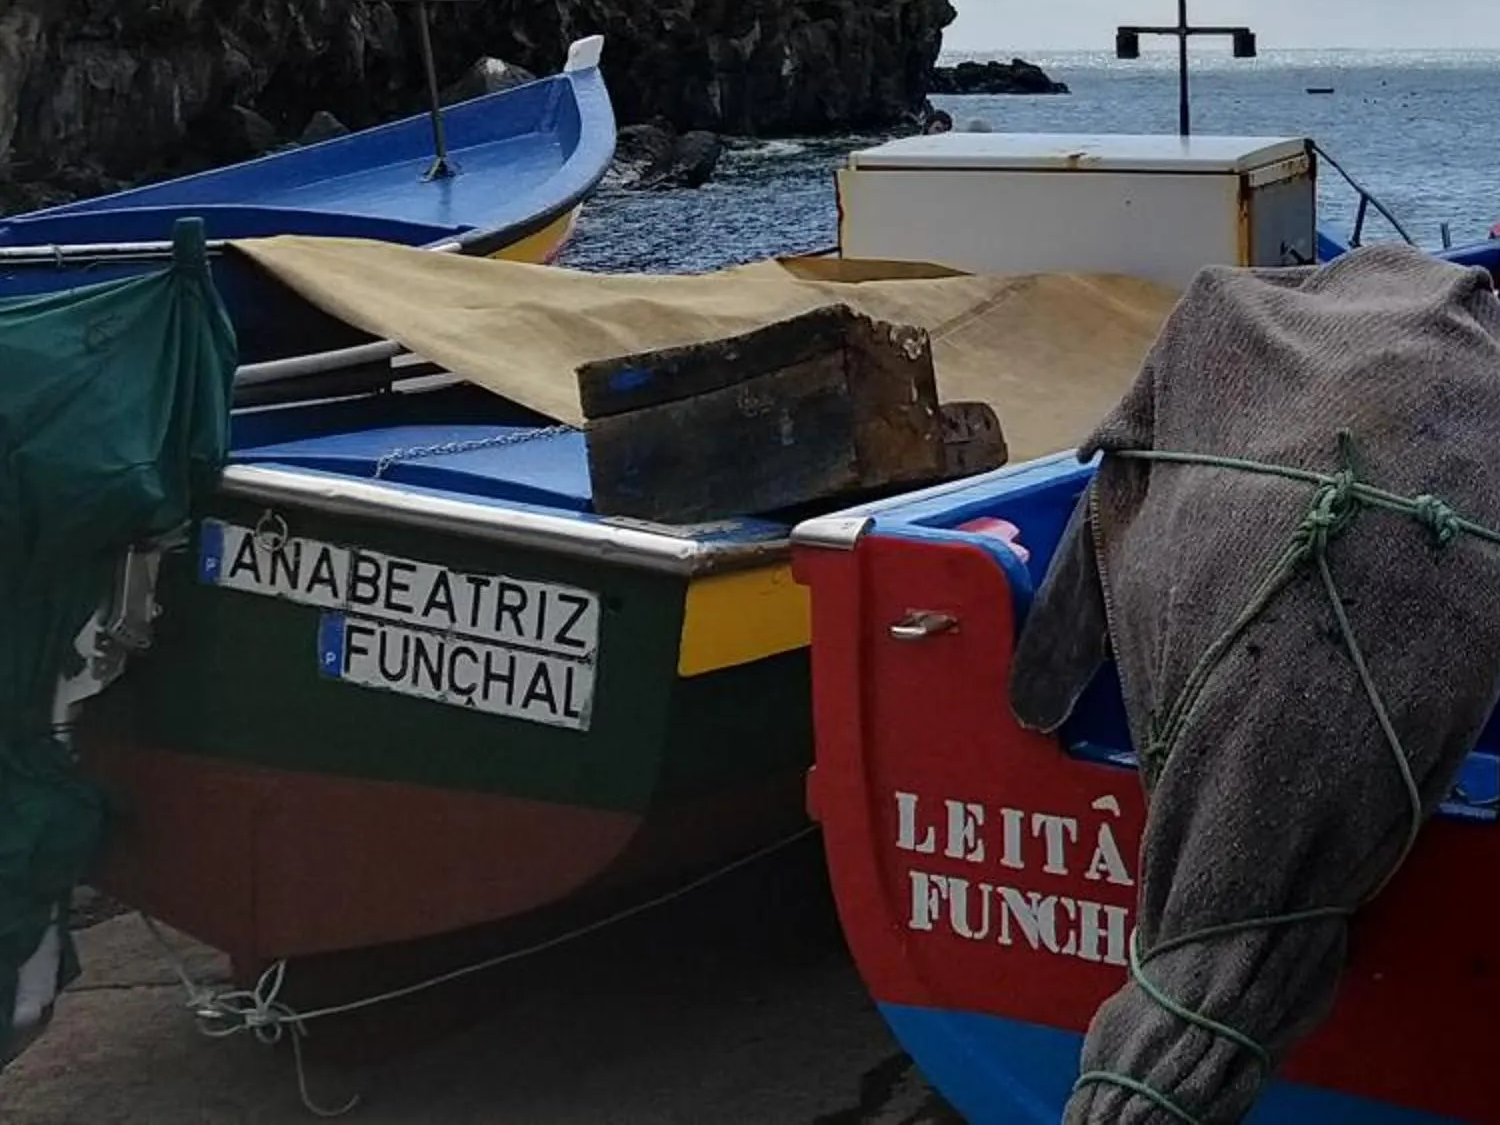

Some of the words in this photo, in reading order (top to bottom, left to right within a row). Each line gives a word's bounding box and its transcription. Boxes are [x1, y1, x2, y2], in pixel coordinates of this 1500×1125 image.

[229, 532, 589, 649] ANABEATRIZ
[343, 624, 582, 719] FUNCHAL
[909, 870, 1128, 966] FUNCH
